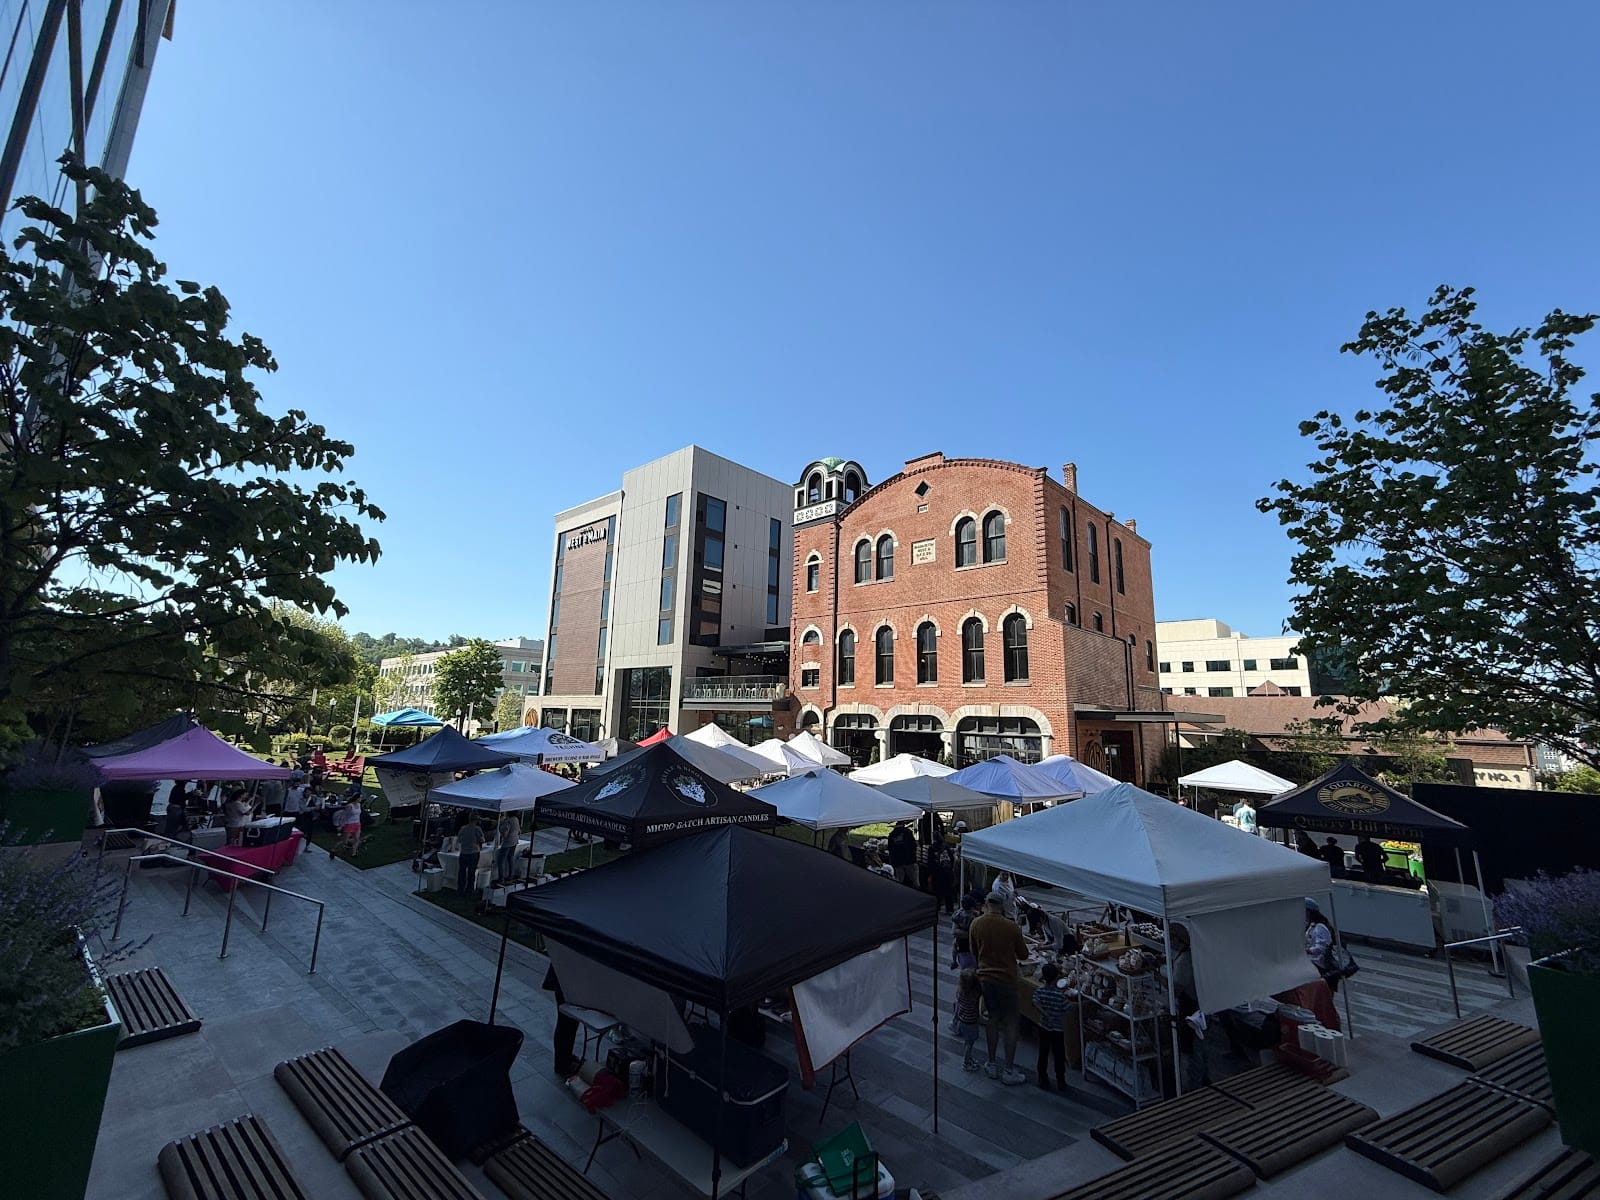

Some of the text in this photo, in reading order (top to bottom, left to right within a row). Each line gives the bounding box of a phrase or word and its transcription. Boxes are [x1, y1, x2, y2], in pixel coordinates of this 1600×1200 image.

[1328, 781, 1377, 794] QUARRY
[704, 814, 739, 826] ARTISAN
[738, 813, 769, 823] CANDLES
[1294, 815, 1425, 838] Quarry Hill Farm
